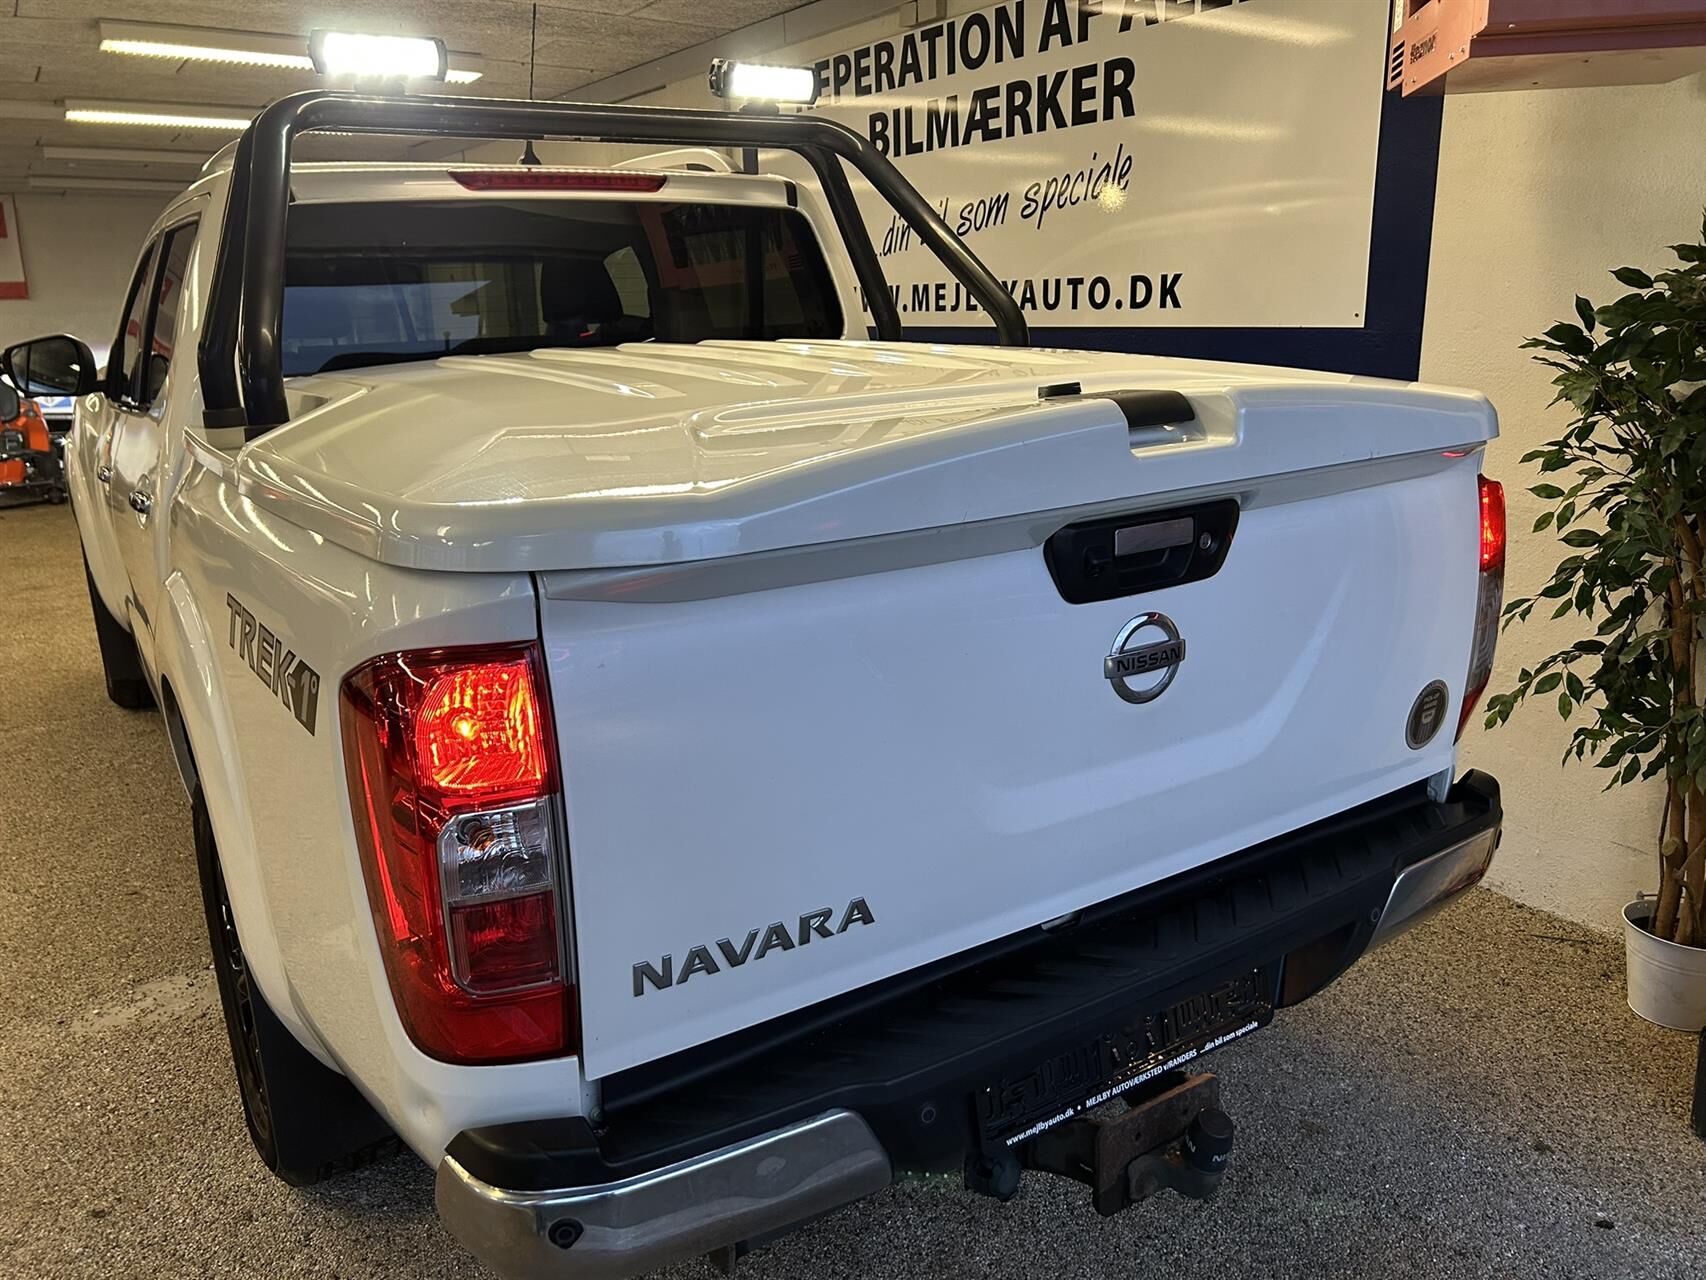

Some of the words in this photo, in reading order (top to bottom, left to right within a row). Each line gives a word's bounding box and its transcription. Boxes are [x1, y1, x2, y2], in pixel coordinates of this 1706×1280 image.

[797, 0, 1024, 113] EPERATION
[869, 57, 1136, 158] BILMÆRKER
[956, 191, 1010, 237] som
[1020, 143, 1133, 230] speciale
[1117, 646, 1181, 672] NISSAN
[632, 896, 875, 998] NAVARA
[1006, 1107, 1074, 1146] www.mejlbyauto.dk
[1085, 1089, 1111, 1108] MEJLBY
[1112, 1065, 1163, 1096] AUTOVÆRKSTED
